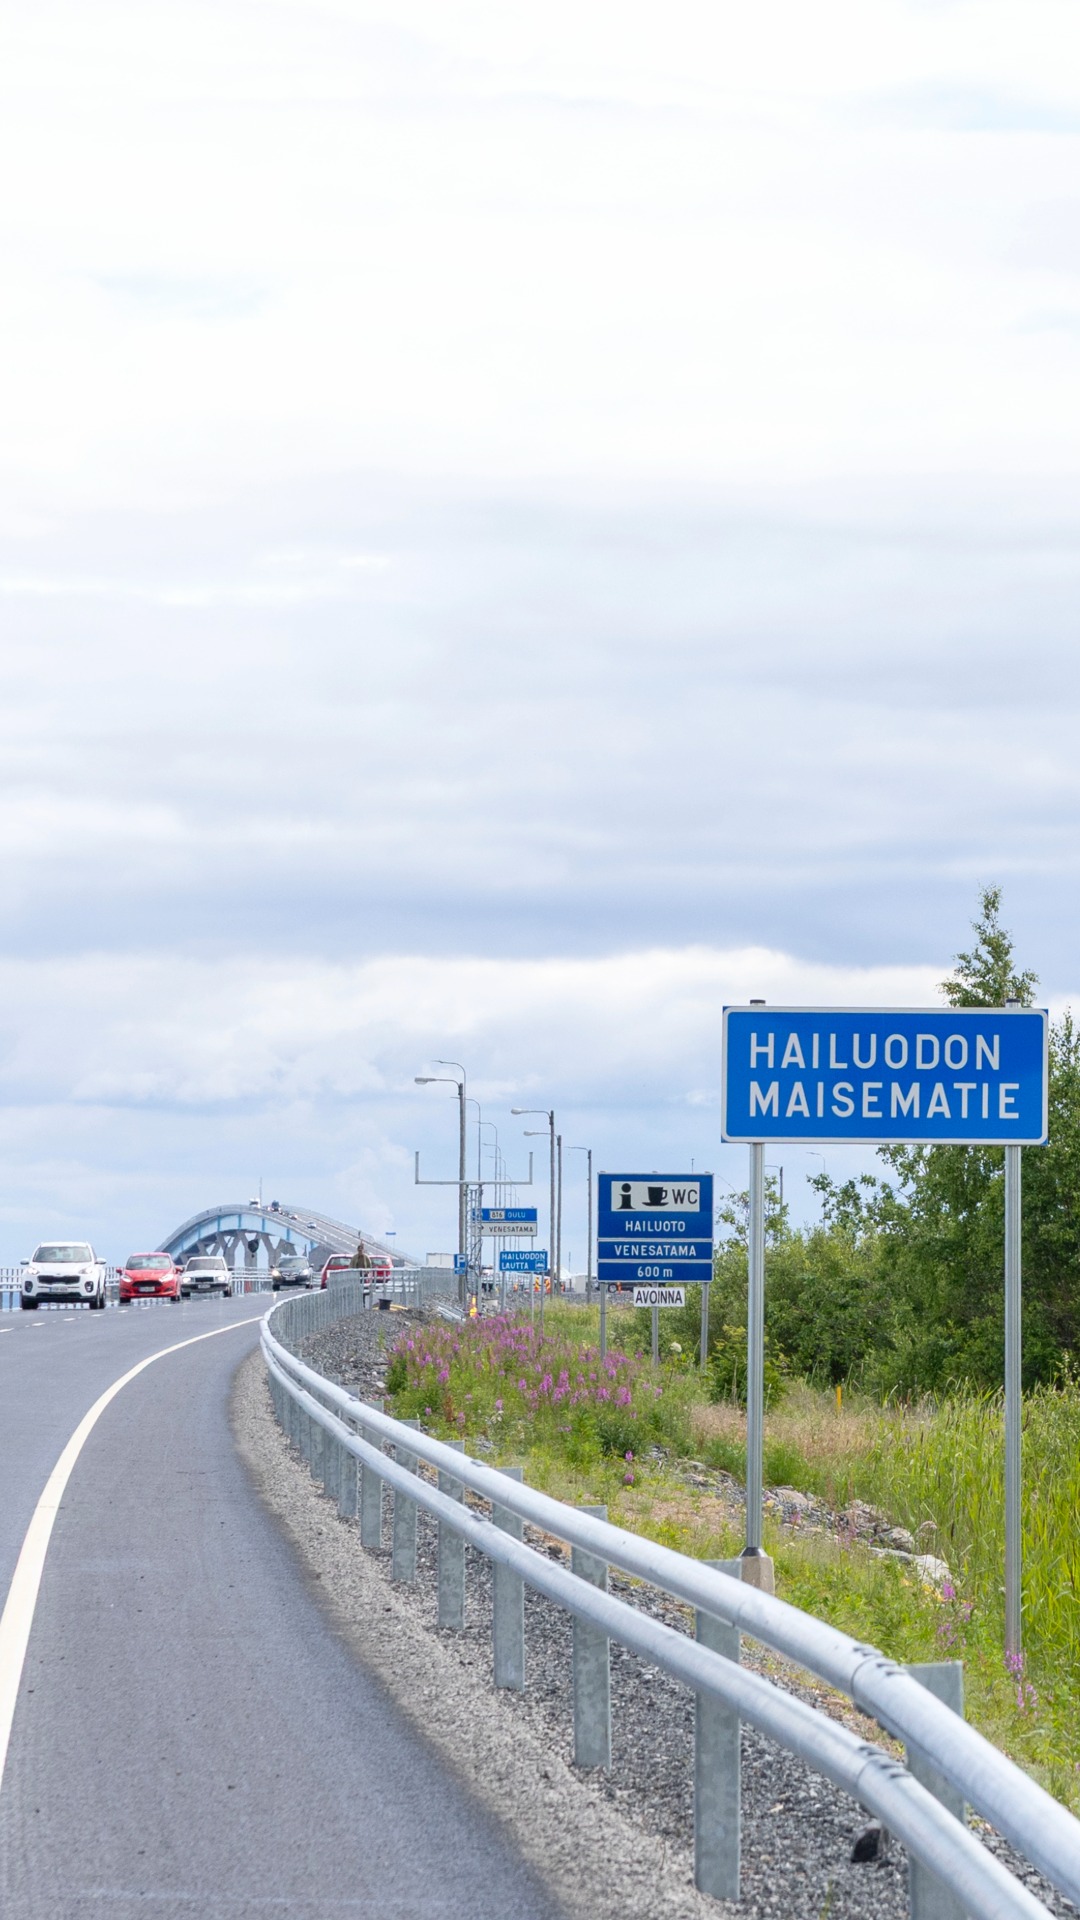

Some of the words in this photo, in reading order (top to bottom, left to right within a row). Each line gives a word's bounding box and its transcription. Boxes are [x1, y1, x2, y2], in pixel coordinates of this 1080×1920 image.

[750, 1033, 1000, 1070] HAILUODON
[749, 1081, 1020, 1120] MAISEMATIE
[672, 1189, 698, 1205] WC
[625, 1220, 686, 1232] HAILUOTO
[614, 1245, 697, 1257] VENESATAMA
[457, 1255, 465, 1267] P
[637, 1266, 660, 1277] 600
[663, 1268, 673, 1277] m
[635, 1290, 683, 1304] AVOINNA
